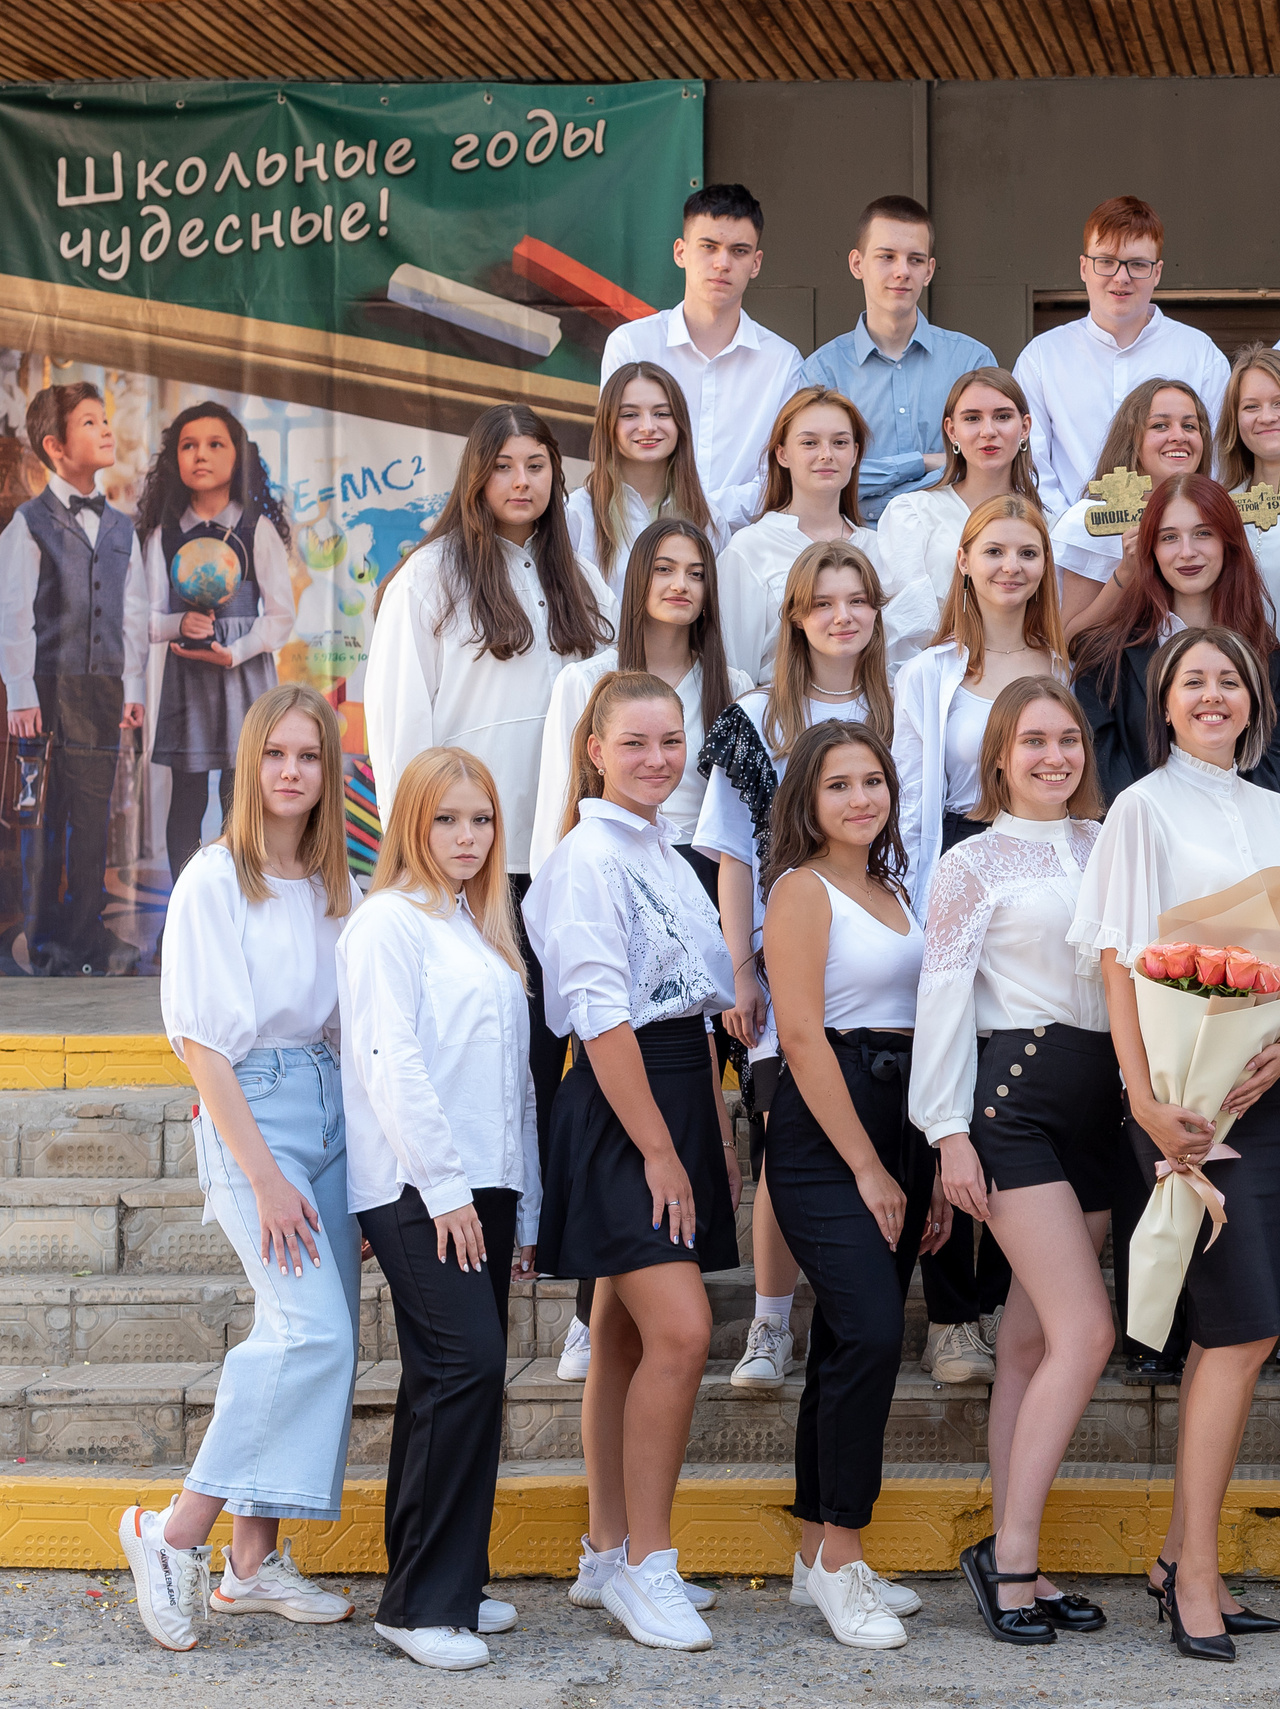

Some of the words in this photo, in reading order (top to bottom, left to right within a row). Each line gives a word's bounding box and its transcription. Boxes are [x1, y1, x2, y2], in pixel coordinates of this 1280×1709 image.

[57, 137, 417, 207] Школьные
[451, 108, 606, 170] годы
[59, 187, 389, 281] чудесные!
[1091, 509, 1130, 525] ШКОЛЕ
[160, 1549, 170, 1570] CALVIN
[164, 1570, 173, 1587] KLEIN
[167, 1586, 177, 1606] JEANS
